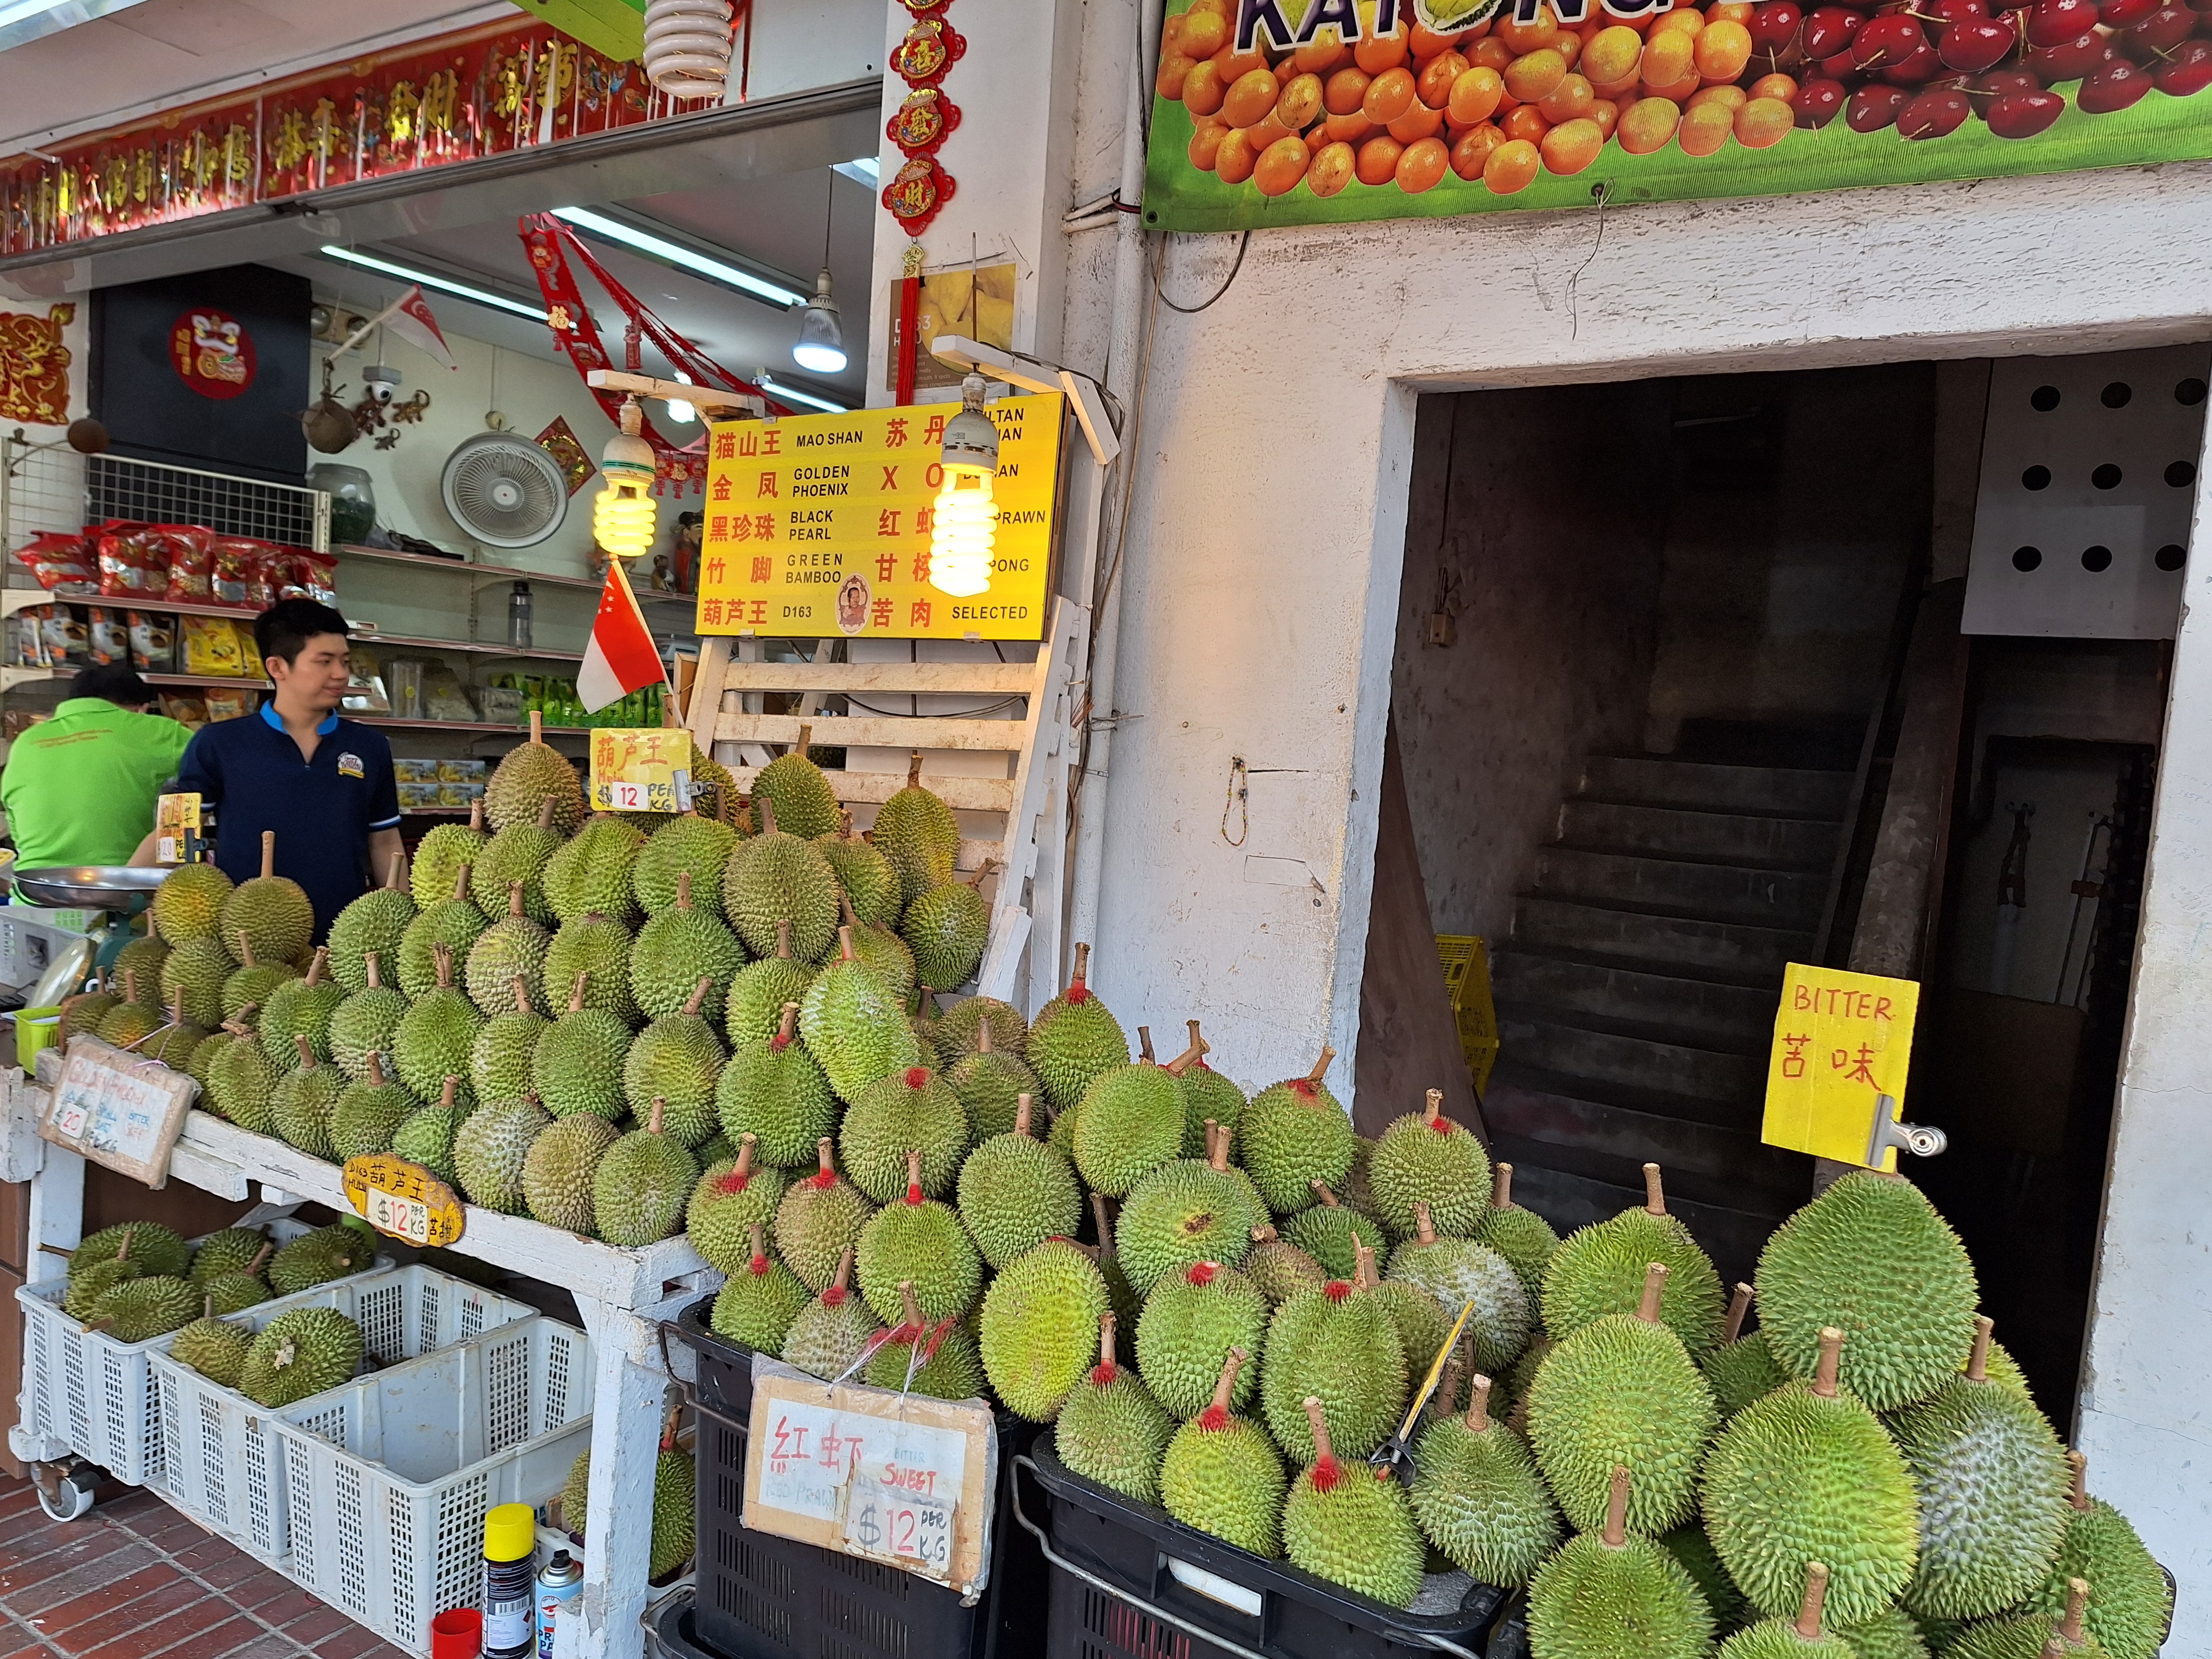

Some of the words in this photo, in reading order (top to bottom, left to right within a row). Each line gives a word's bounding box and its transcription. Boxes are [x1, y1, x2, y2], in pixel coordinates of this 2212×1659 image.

[715, 430, 782, 460] 猫山王
[797, 434, 825, 447] MAO
[827, 430, 863, 445] SHAN
[794, 465, 850, 480] GOLDEN
[793, 483, 848, 497] PHOENIX
[790, 510, 834, 523] BLACK
[709, 513, 776, 543] 黑珍珠
[789, 528, 832, 541] PEARL
[787, 554, 843, 567] GREEN
[786, 571, 841, 584] BAMBOO
[703, 598, 768, 626] 葫芦王
[783, 606, 812, 618] D163
[951, 606, 1028, 619] SELECTED
[1794, 983, 1896, 1022] BITTER
[62, 1110, 80, 1131] 20
[349, 1162, 368, 1178] D163
[370, 1162, 425, 1203] 葫芦王
[410, 1204, 426, 1218] PER
[410, 1218, 425, 1236] KG
[880, 1462, 936, 1496] SWEET
[921, 1509, 947, 1530] PER
[919, 1535, 946, 1561] KG
